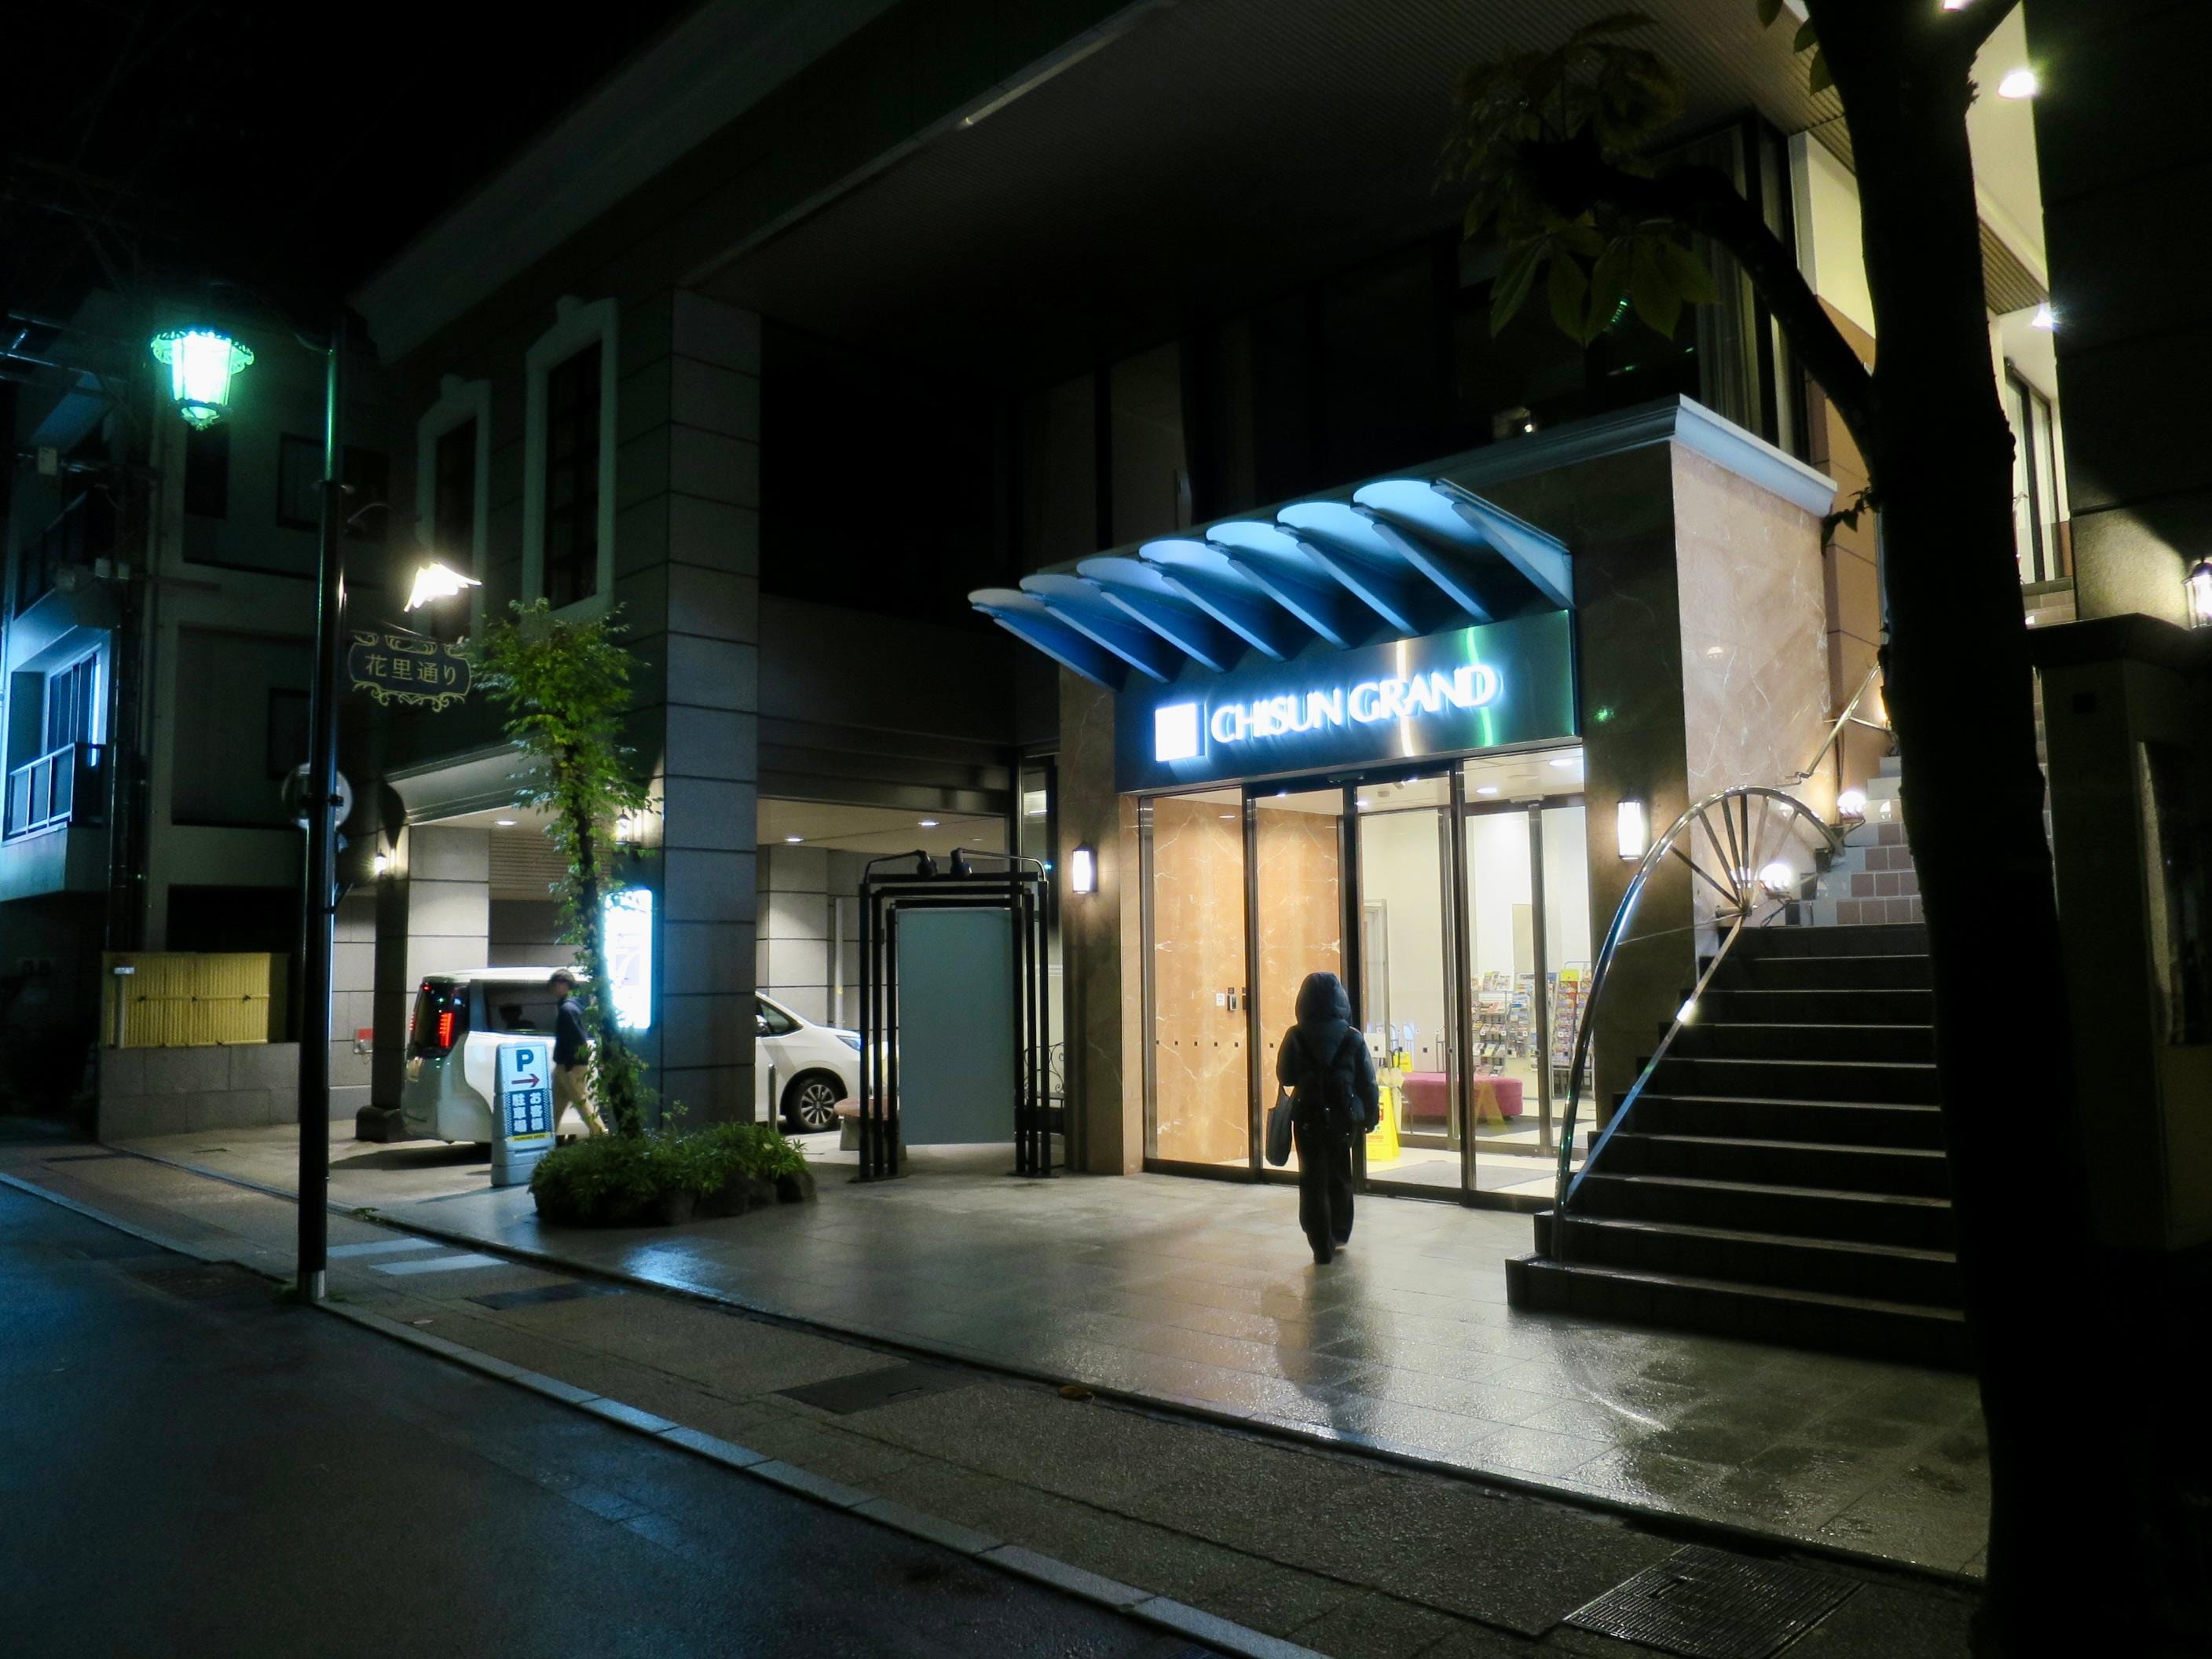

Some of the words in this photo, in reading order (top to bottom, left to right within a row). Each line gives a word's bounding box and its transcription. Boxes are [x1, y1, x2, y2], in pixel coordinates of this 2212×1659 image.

[364, 654, 456, 686] 花里通り
[1210, 687, 1342, 744] CHISUN
[1349, 664, 1496, 723] GRAND
[515, 1049, 534, 1072] P
